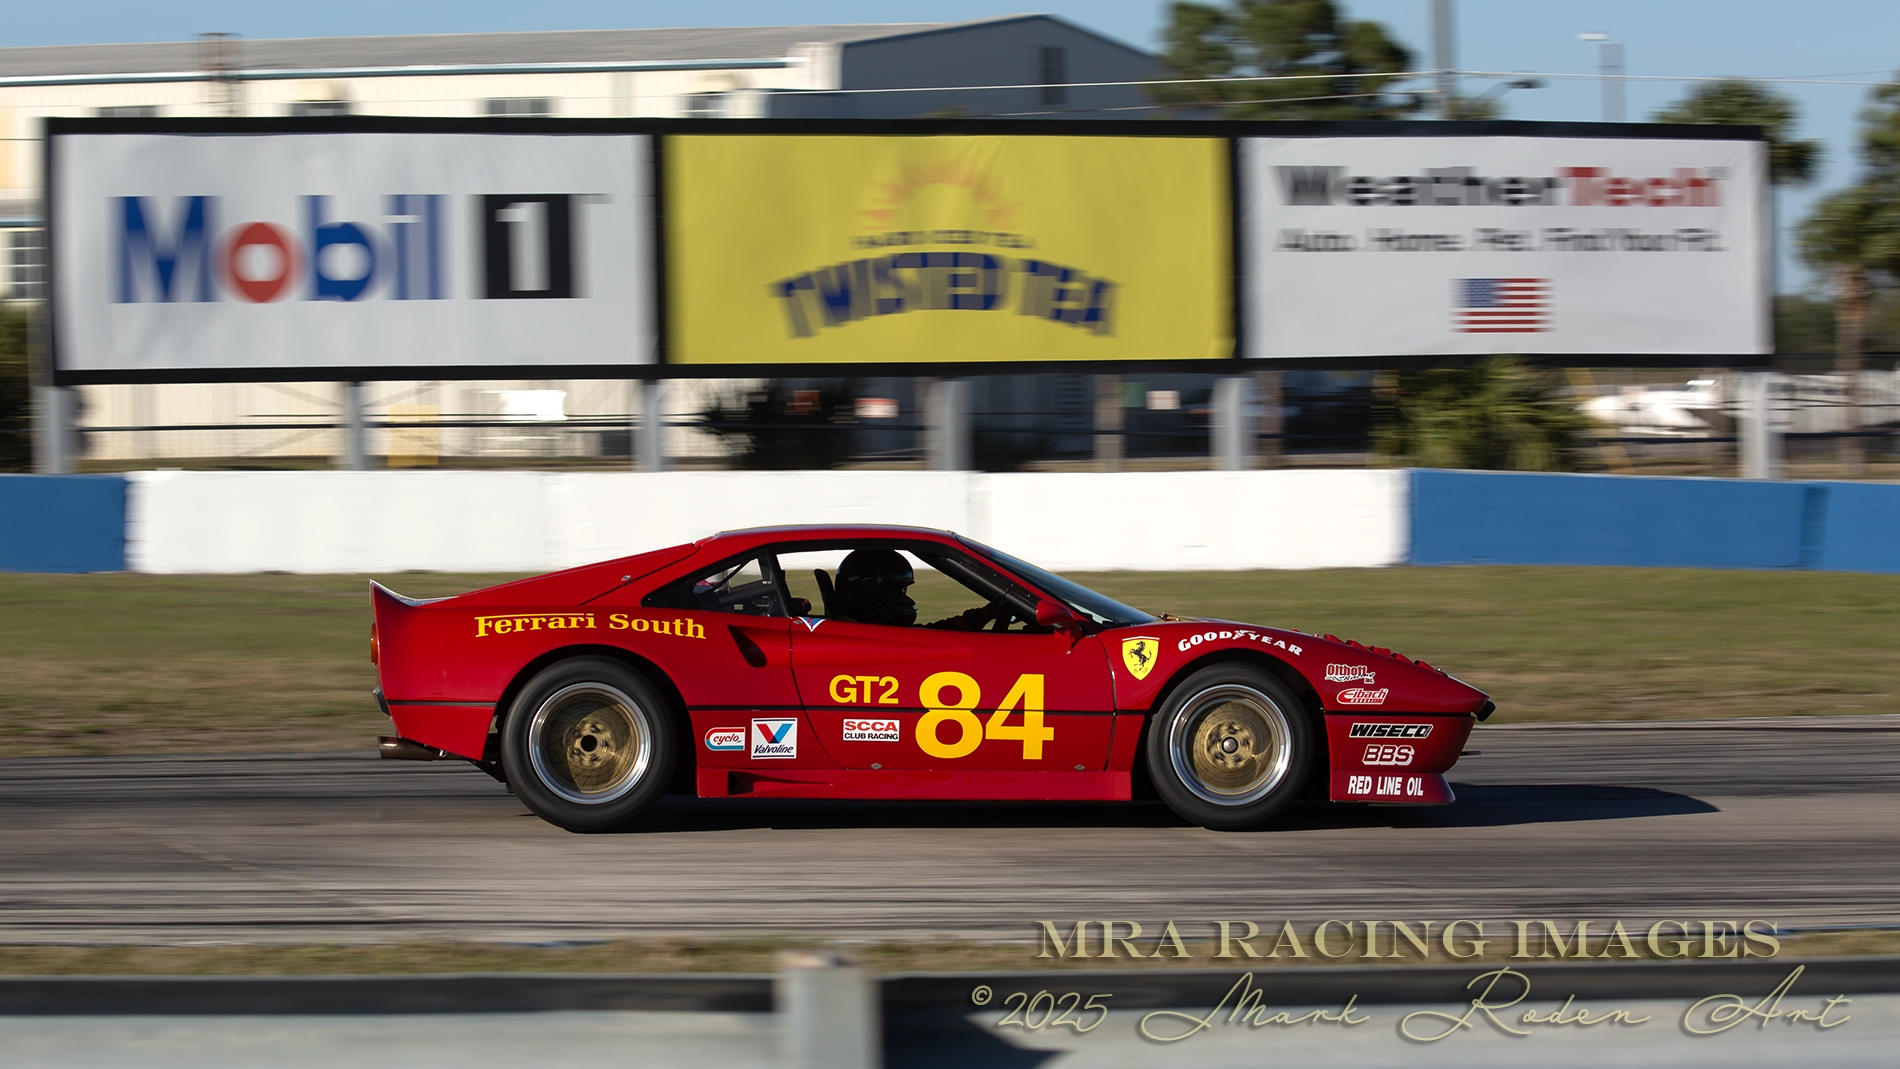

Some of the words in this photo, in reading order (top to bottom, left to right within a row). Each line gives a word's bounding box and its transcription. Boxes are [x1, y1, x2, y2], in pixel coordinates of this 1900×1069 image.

[1269, 165, 1724, 207] WeatherTech
[110, 194, 449, 304] Mobil
[490, 199, 564, 295] 1
[769, 250, 1010, 339] TWISTED
[1008, 257, 1120, 338] TEA
[474, 613, 597, 638] Ferrari
[609, 613, 706, 639] South
[1178, 629, 1302, 656] GOODYEAR
[829, 674, 899, 704] GT2
[1337, 688, 1388, 704] Eibach
[844, 720, 898, 732] SCCA
[915, 671, 1054, 760] 84
[713, 733, 740, 745] cyclo
[844, 732, 867, 740] CLUB
[867, 732, 898, 740] RACING
[1350, 724, 1432, 738] WISECO
[754, 744, 794, 754] Valvoline
[1362, 744, 1414, 766] BBS
[1348, 775, 1372, 794] RED
[1376, 776, 1402, 795] LINE
[1406, 777, 1424, 796] OIL
